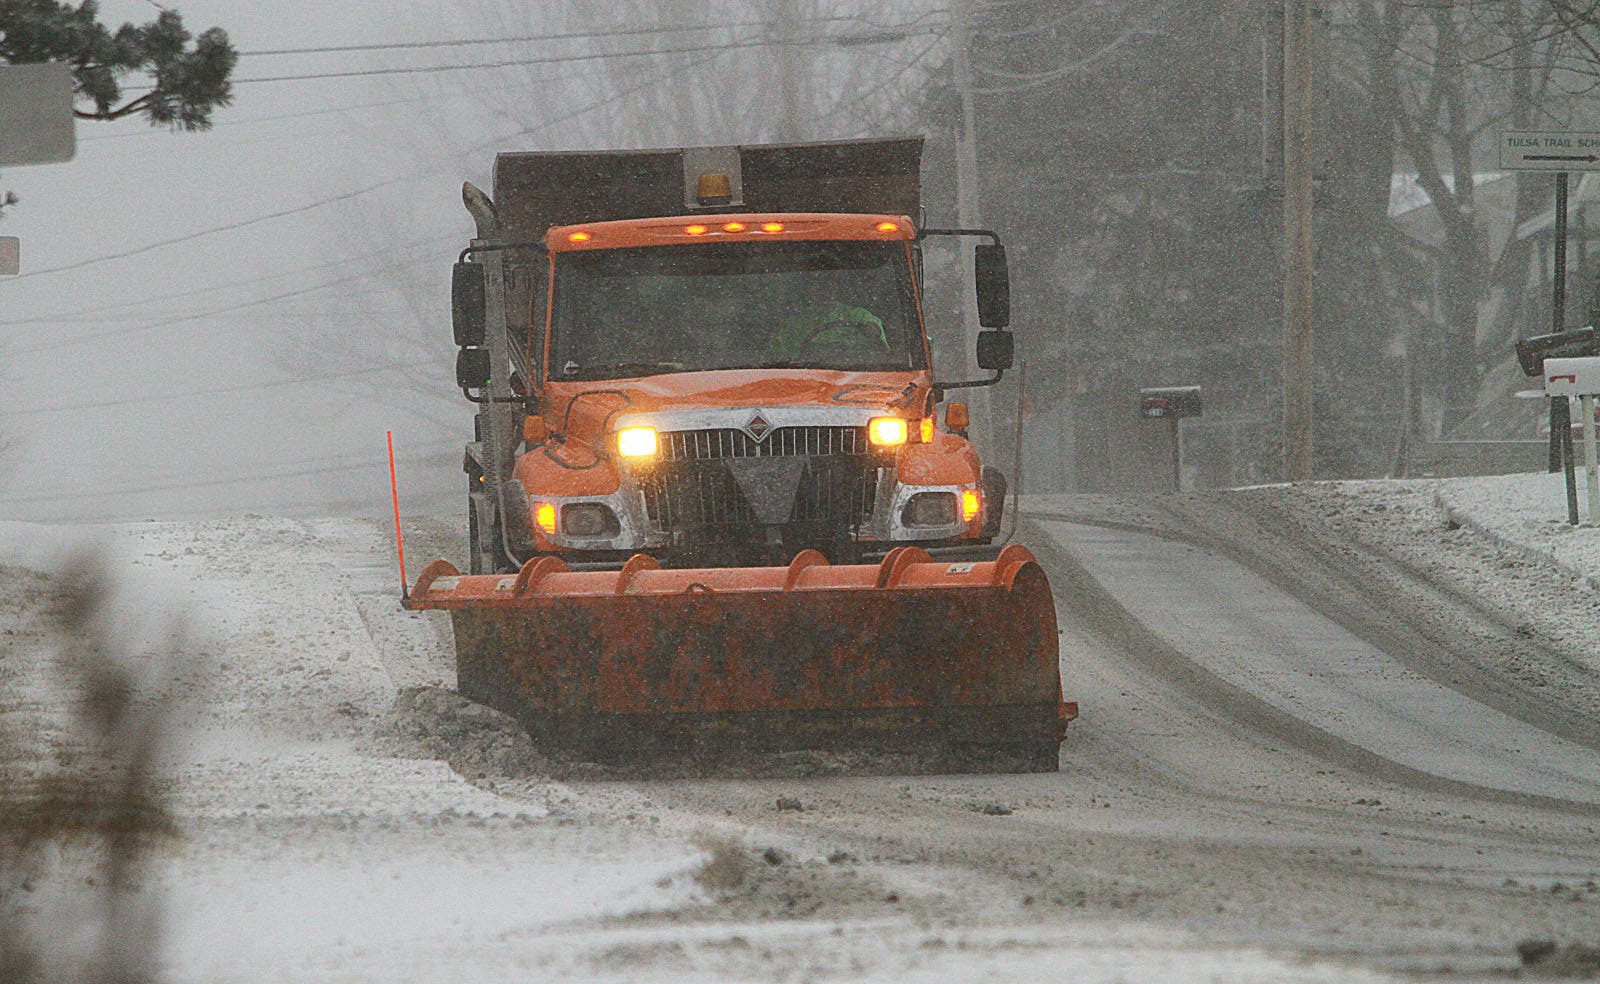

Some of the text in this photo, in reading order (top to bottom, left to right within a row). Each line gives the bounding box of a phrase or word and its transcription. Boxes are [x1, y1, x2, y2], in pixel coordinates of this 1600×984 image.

[1508, 138, 1600, 147] TULSA TRAIL SCH
